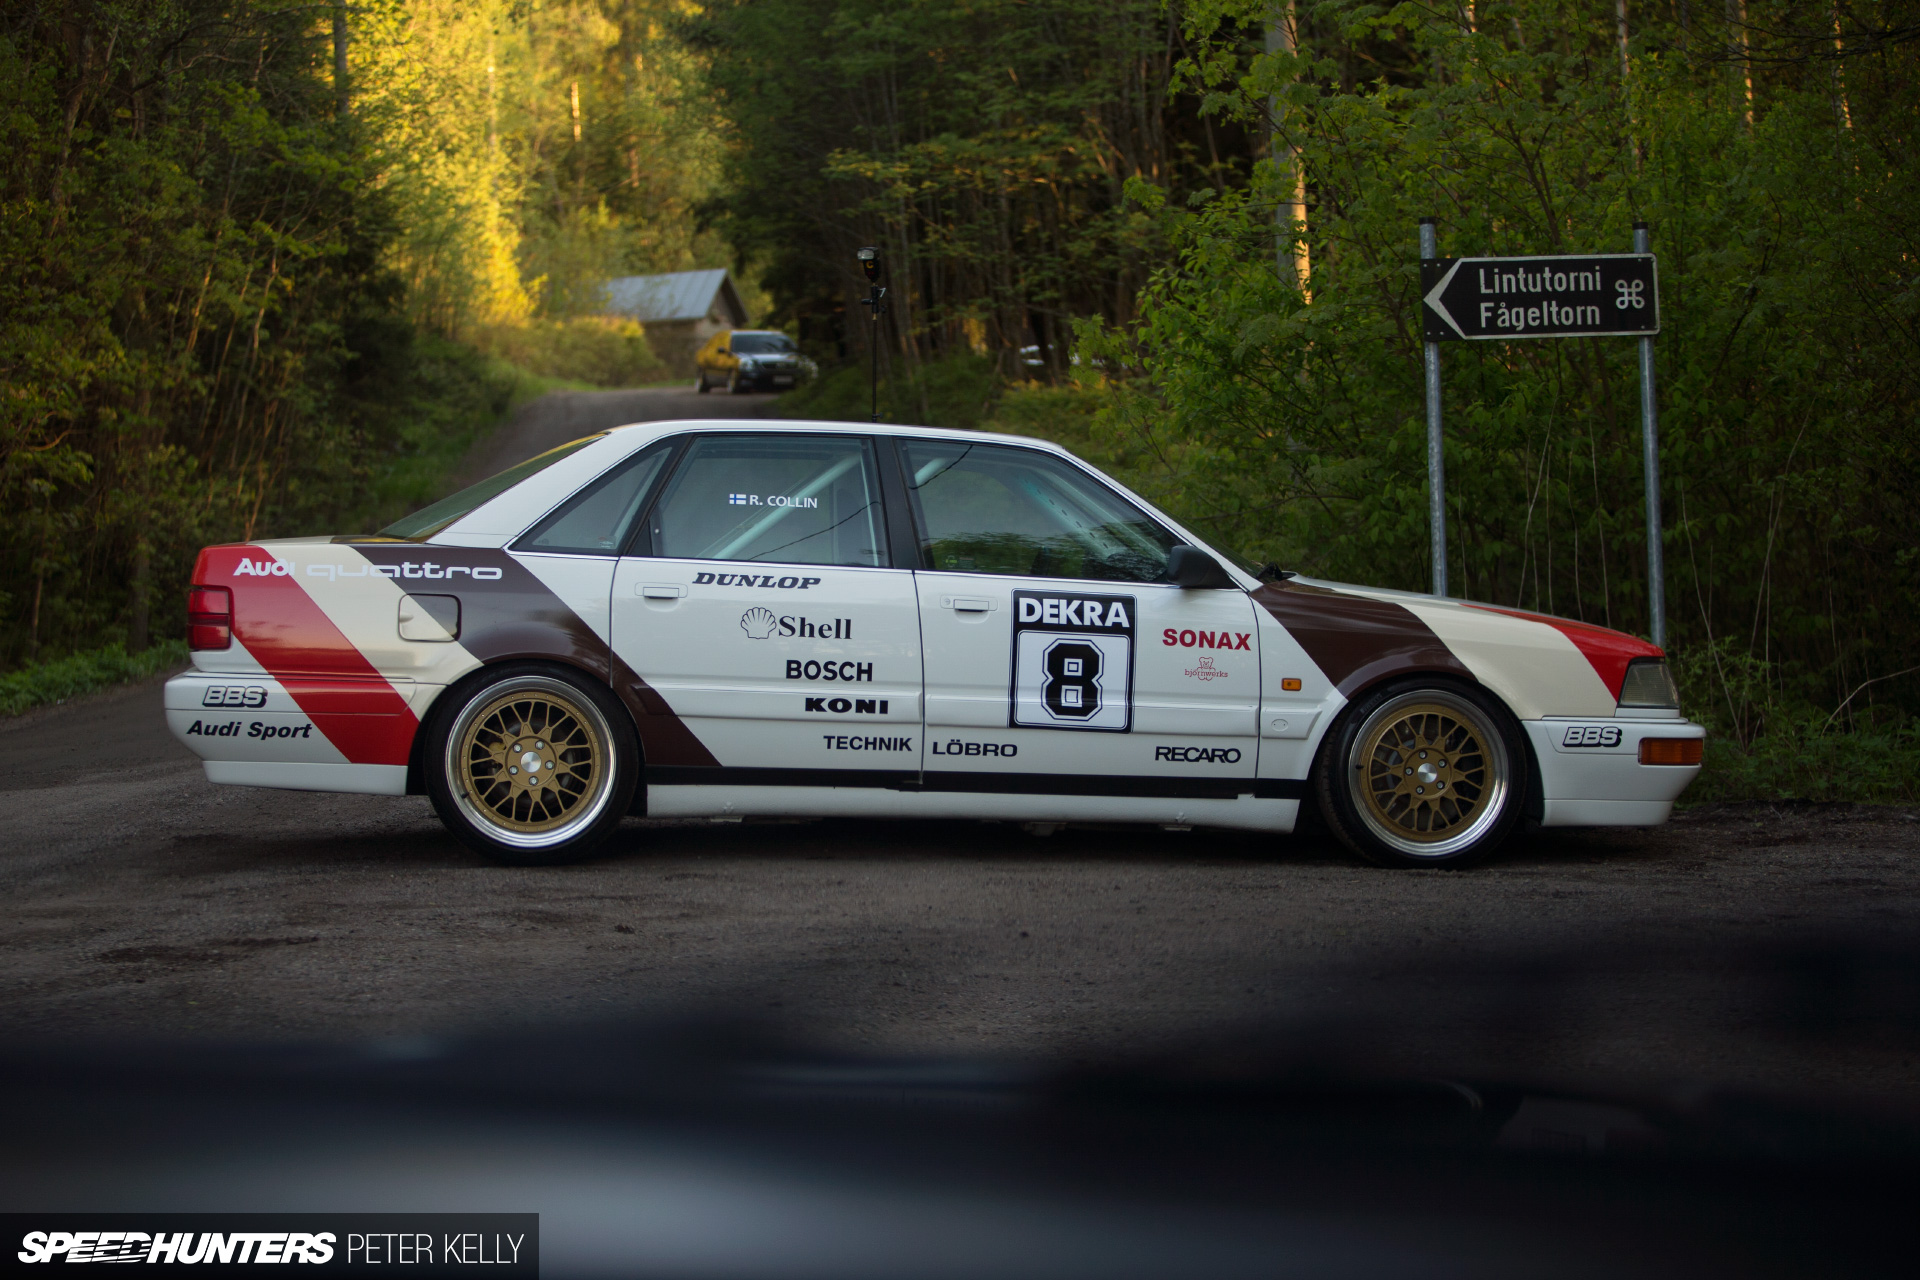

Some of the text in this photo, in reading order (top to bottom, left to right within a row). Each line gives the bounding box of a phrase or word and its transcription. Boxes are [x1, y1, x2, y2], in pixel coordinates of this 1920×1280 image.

[1479, 266, 1601, 294] Lintutorni
[1480, 301, 1600, 331] Fågeltorn
[749, 494, 818, 509] R. COLLIN
[233, 557, 503, 582] Audi quattro
[692, 572, 821, 589] DUNLOP
[1018, 596, 1130, 628] DEKRA
[778, 615, 853, 640] Shell
[1162, 628, 1251, 651] SONAX
[785, 659, 873, 682] BOSCH
[1041, 637, 1105, 722] 8
[202, 685, 268, 708] BBS
[804, 697, 889, 715] KONI
[186, 719, 312, 741] Audi Sport
[1563, 726, 1622, 747] BBS
[823, 735, 913, 752] TECHNIK
[932, 739, 1018, 758] LÖBRO
[1155, 746, 1242, 763] RECARO
